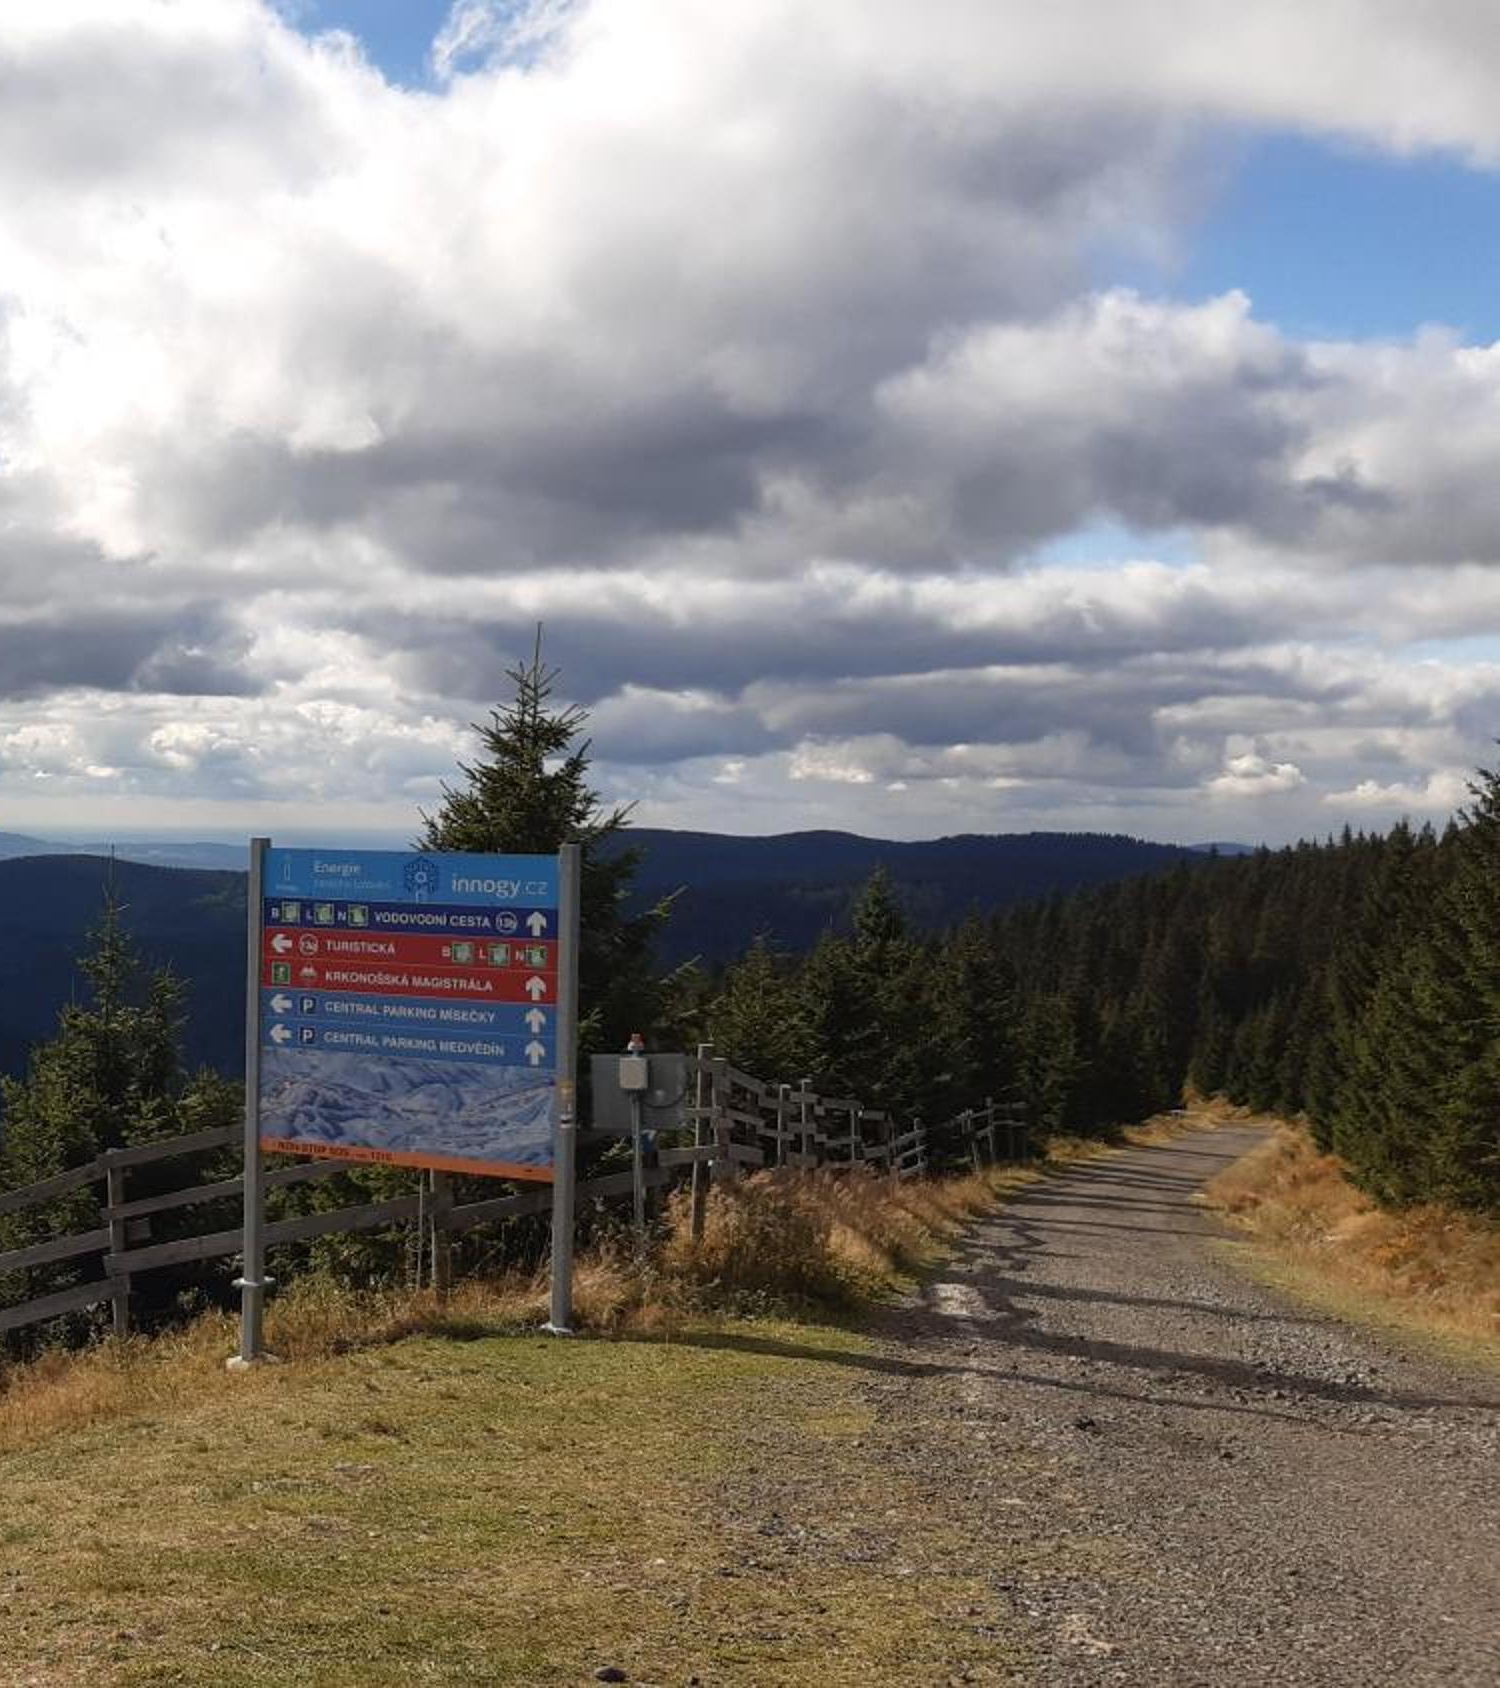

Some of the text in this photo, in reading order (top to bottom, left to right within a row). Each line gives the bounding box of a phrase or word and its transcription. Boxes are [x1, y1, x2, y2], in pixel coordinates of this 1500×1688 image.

[314, 861, 361, 876] Energie
[452, 873, 549, 899] innogy.cz
[450, 915, 491, 929] CESTA
[325, 940, 396, 955] TURISTICKÁ
[479, 948, 487, 959] L
[325, 970, 493, 992] KRKONOŠSKÁ MAGISTRÁLA
[303, 998, 313, 1013] P
[324, 1001, 381, 1015] CENTRAL
[383, 1004, 437, 1019] PARKING
[303, 1028, 313, 1043] P
[324, 1032, 379, 1047] CENTRAL
[382, 1035, 437, 1051] PARKING
